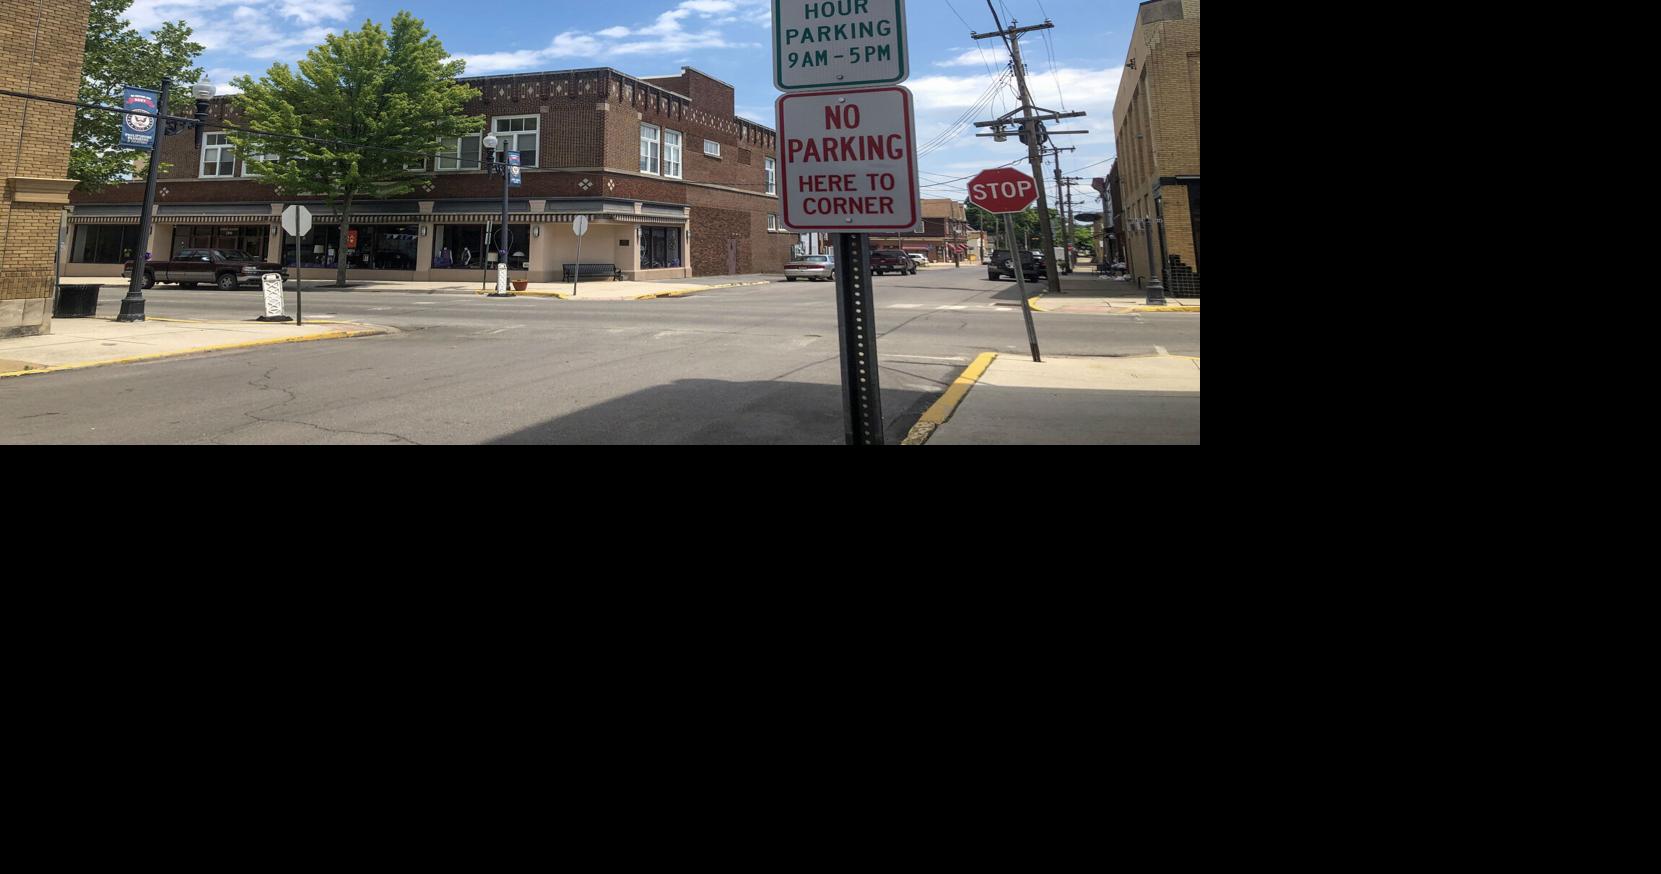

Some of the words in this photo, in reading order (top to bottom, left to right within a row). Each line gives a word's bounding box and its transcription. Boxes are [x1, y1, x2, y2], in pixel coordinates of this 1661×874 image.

[805, 0, 868, 19] HOUR
[786, 20, 891, 45] PARKING
[825, 104, 860, 130] NO
[788, 134, 903, 163] PARKING
[799, 174, 857, 192] HERE
[866, 172, 895, 191] TO
[972, 180, 1032, 201] STOP
[803, 196, 894, 215] CORNER
